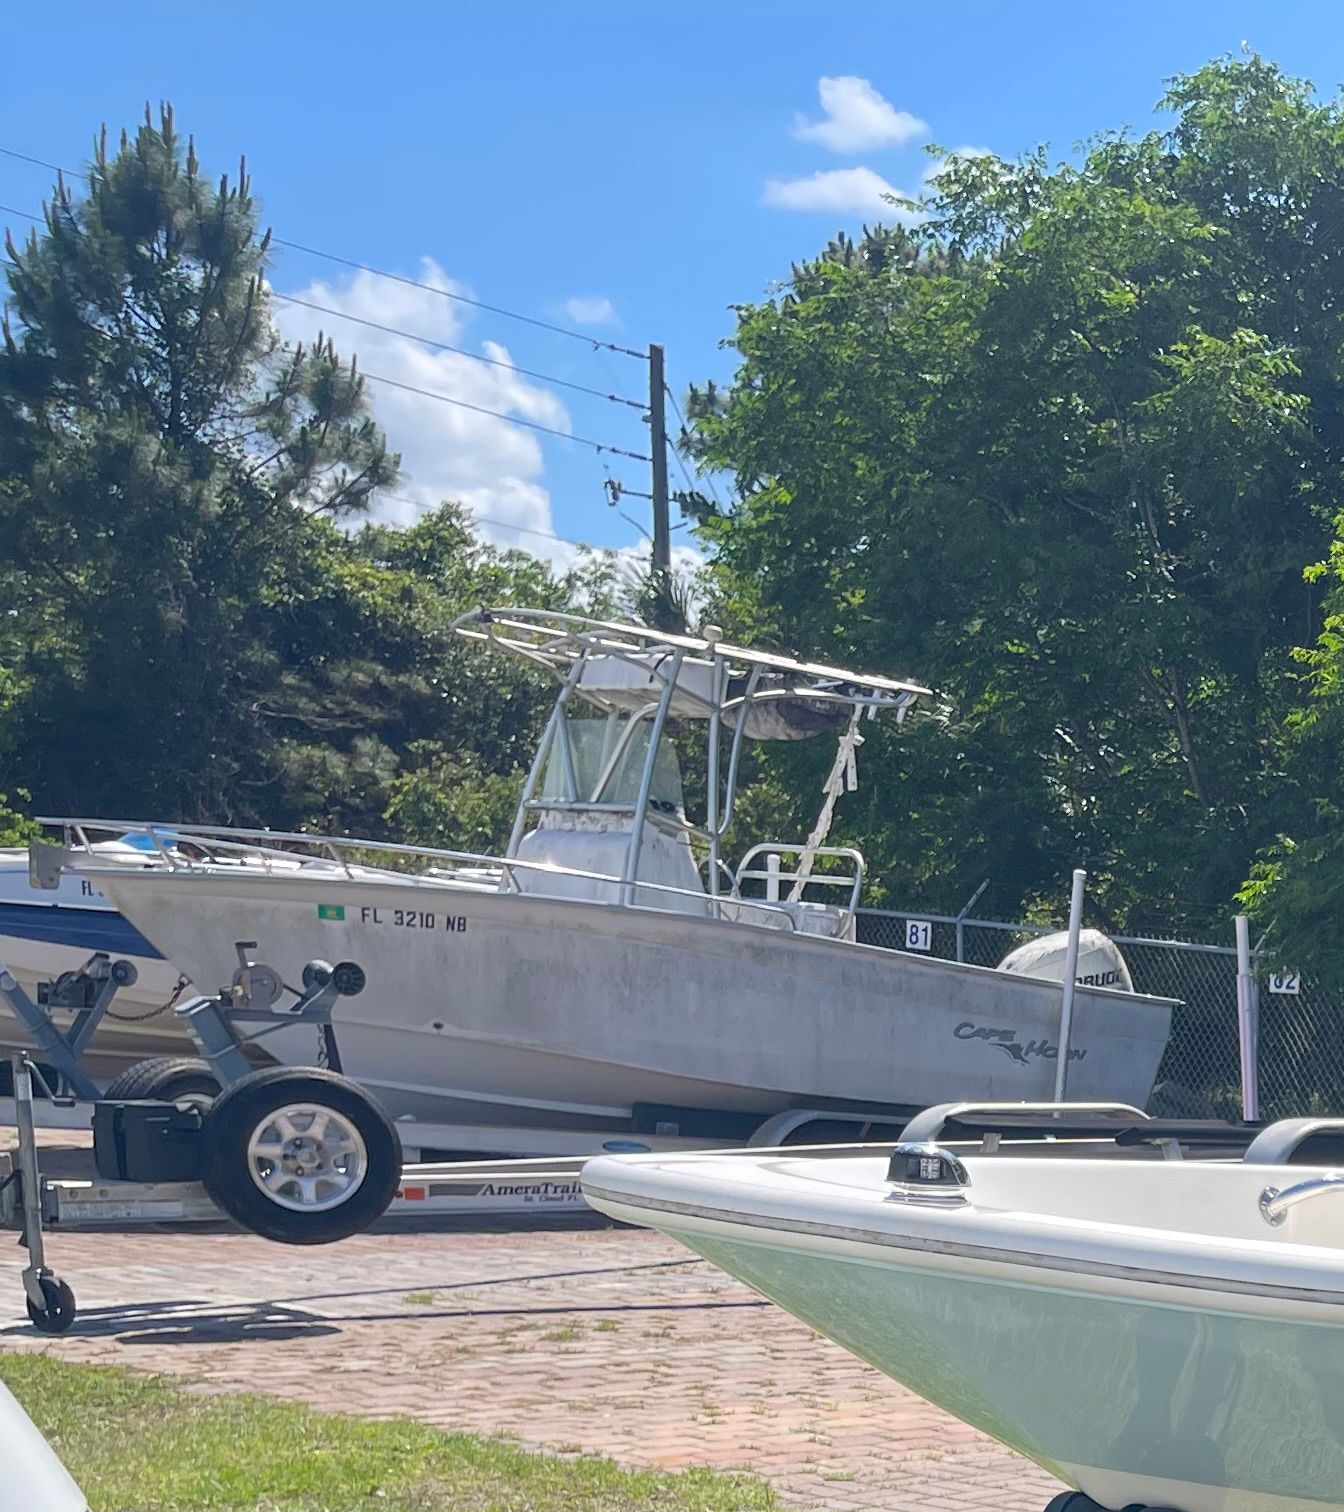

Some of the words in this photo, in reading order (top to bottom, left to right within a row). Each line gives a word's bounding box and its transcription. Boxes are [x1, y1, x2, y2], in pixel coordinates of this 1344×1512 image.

[81, 880, 93, 896] FL
[361, 907, 382, 924] FL
[394, 910, 435, 929] 3210
[446, 916, 467, 932] NB
[910, 924, 928, 946] 81
